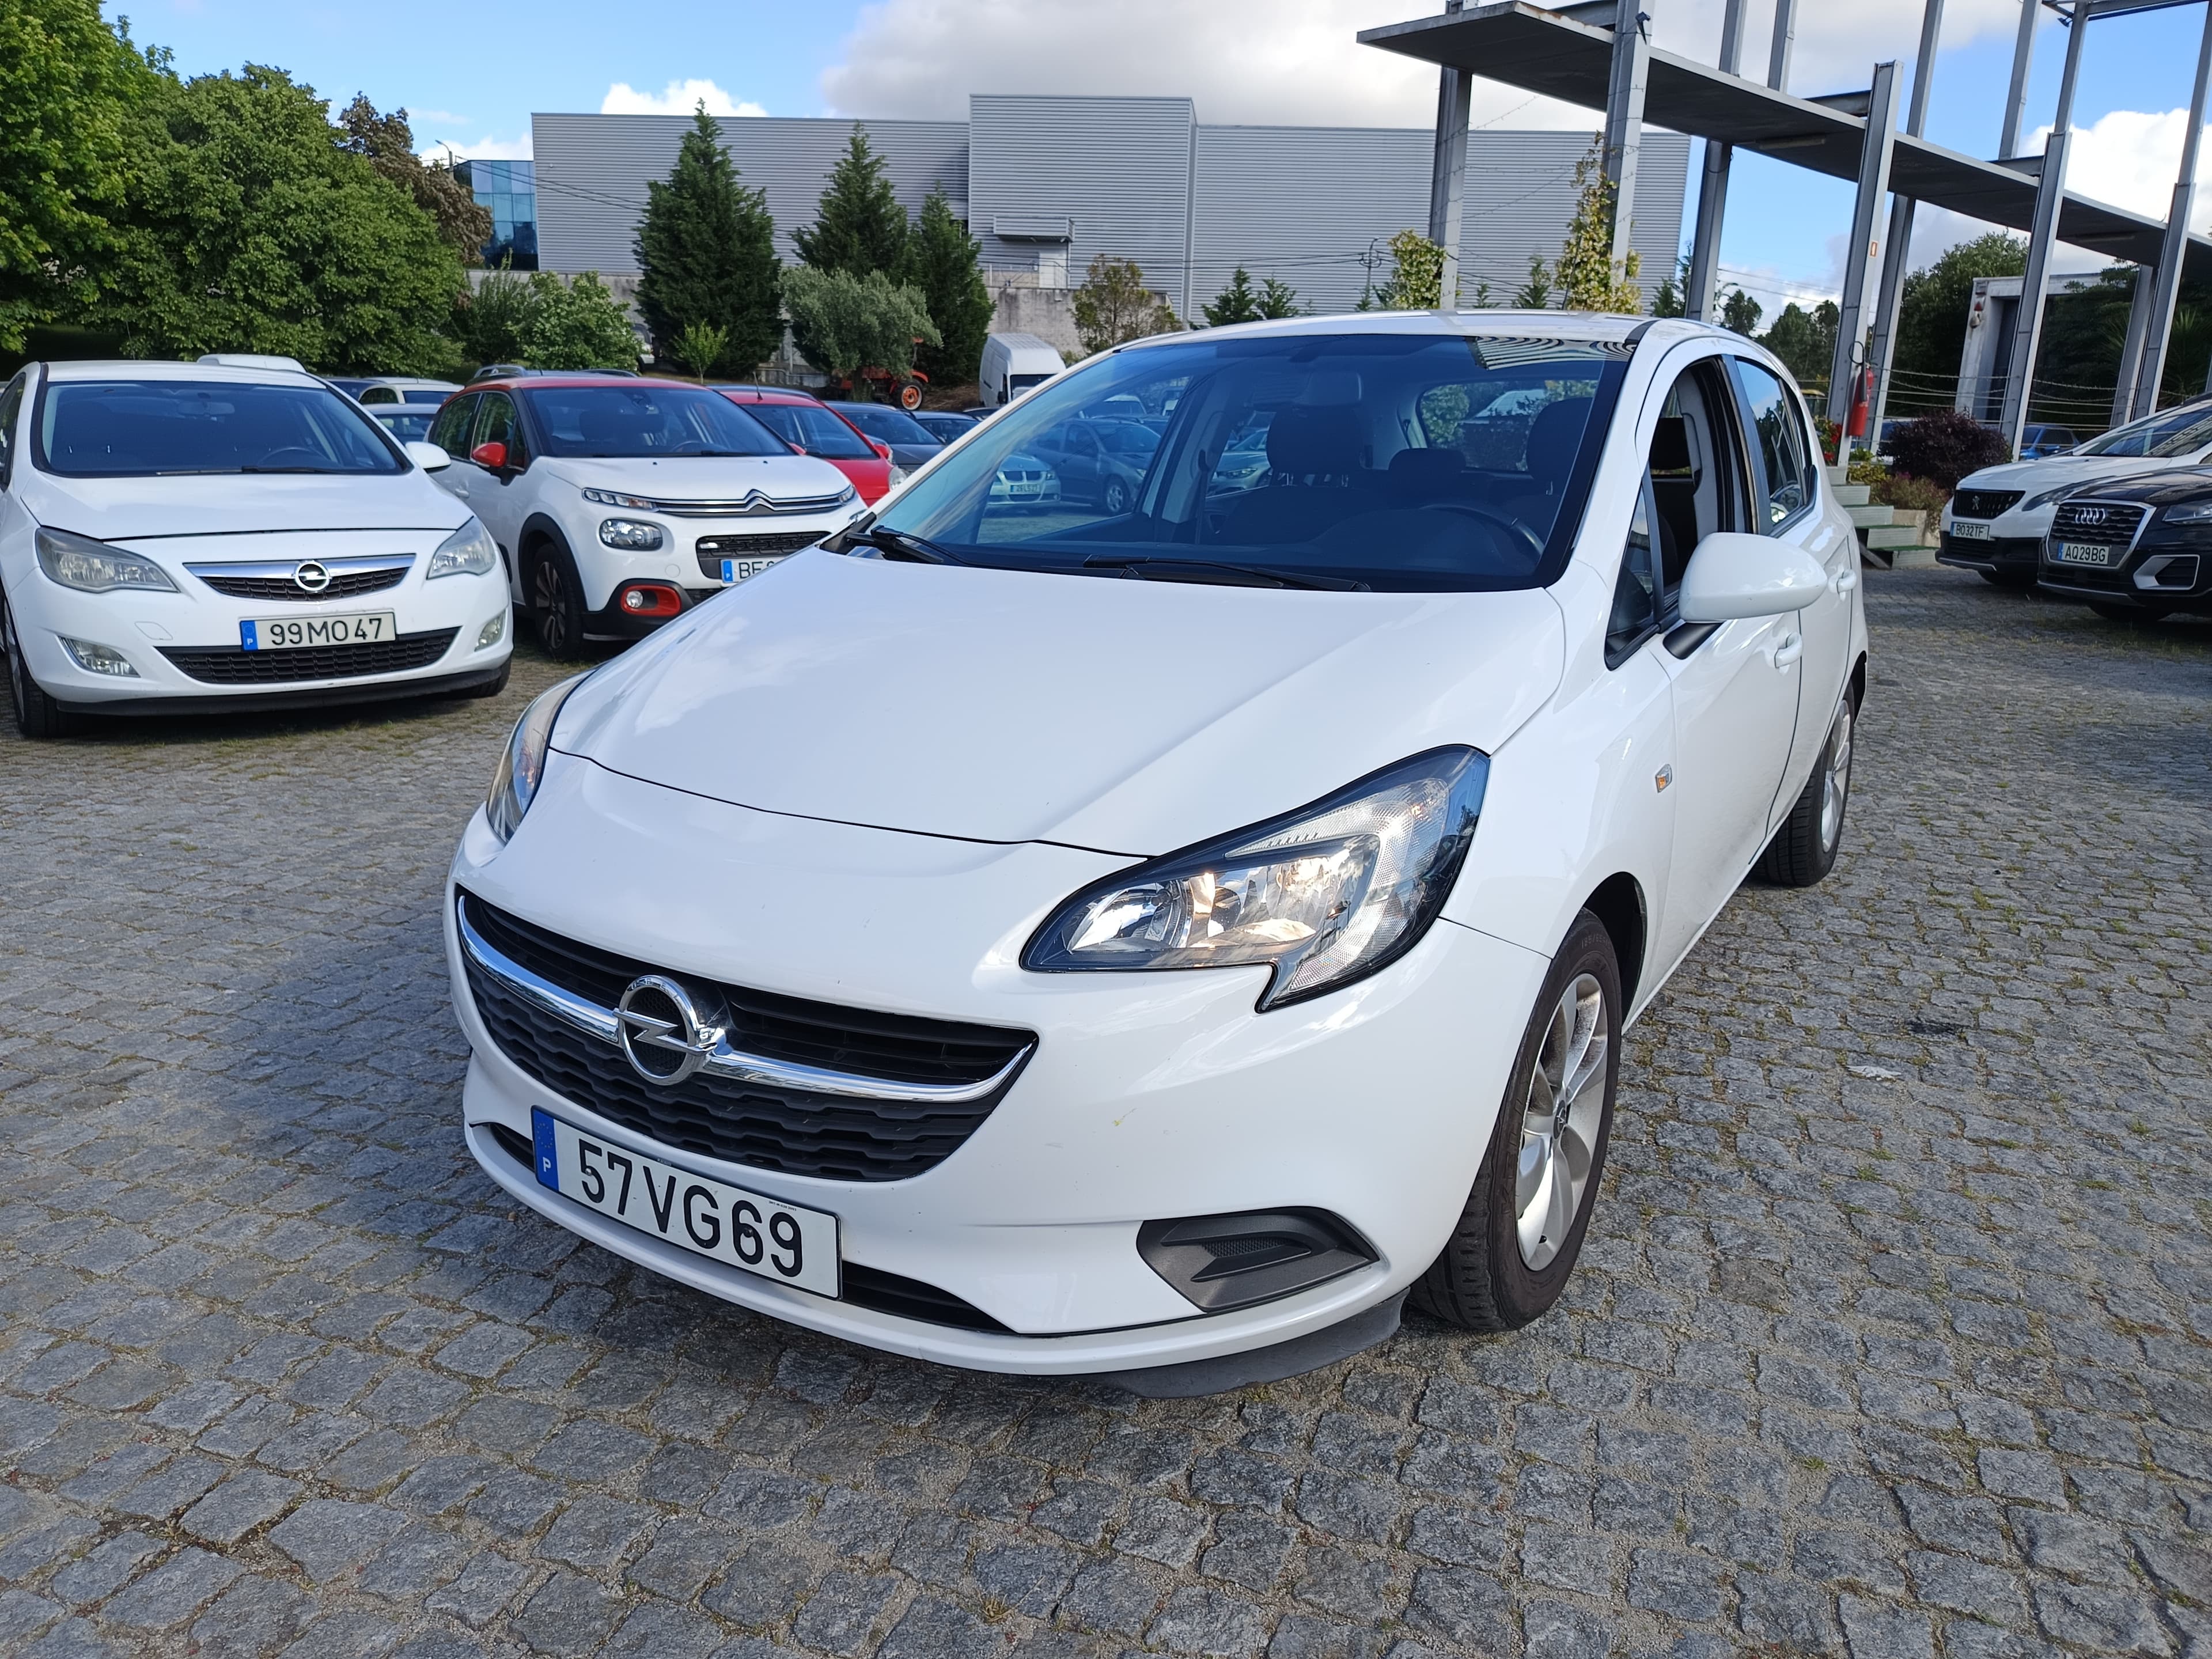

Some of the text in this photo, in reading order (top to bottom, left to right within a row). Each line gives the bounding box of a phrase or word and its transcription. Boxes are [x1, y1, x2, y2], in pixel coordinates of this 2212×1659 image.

[1956, 524, 1984, 538] BO32TF
[2065, 545, 2105, 562] AQ29BG
[247, 618, 382, 646] P 99MO47
[542, 1138, 802, 1277] P 57VG69
